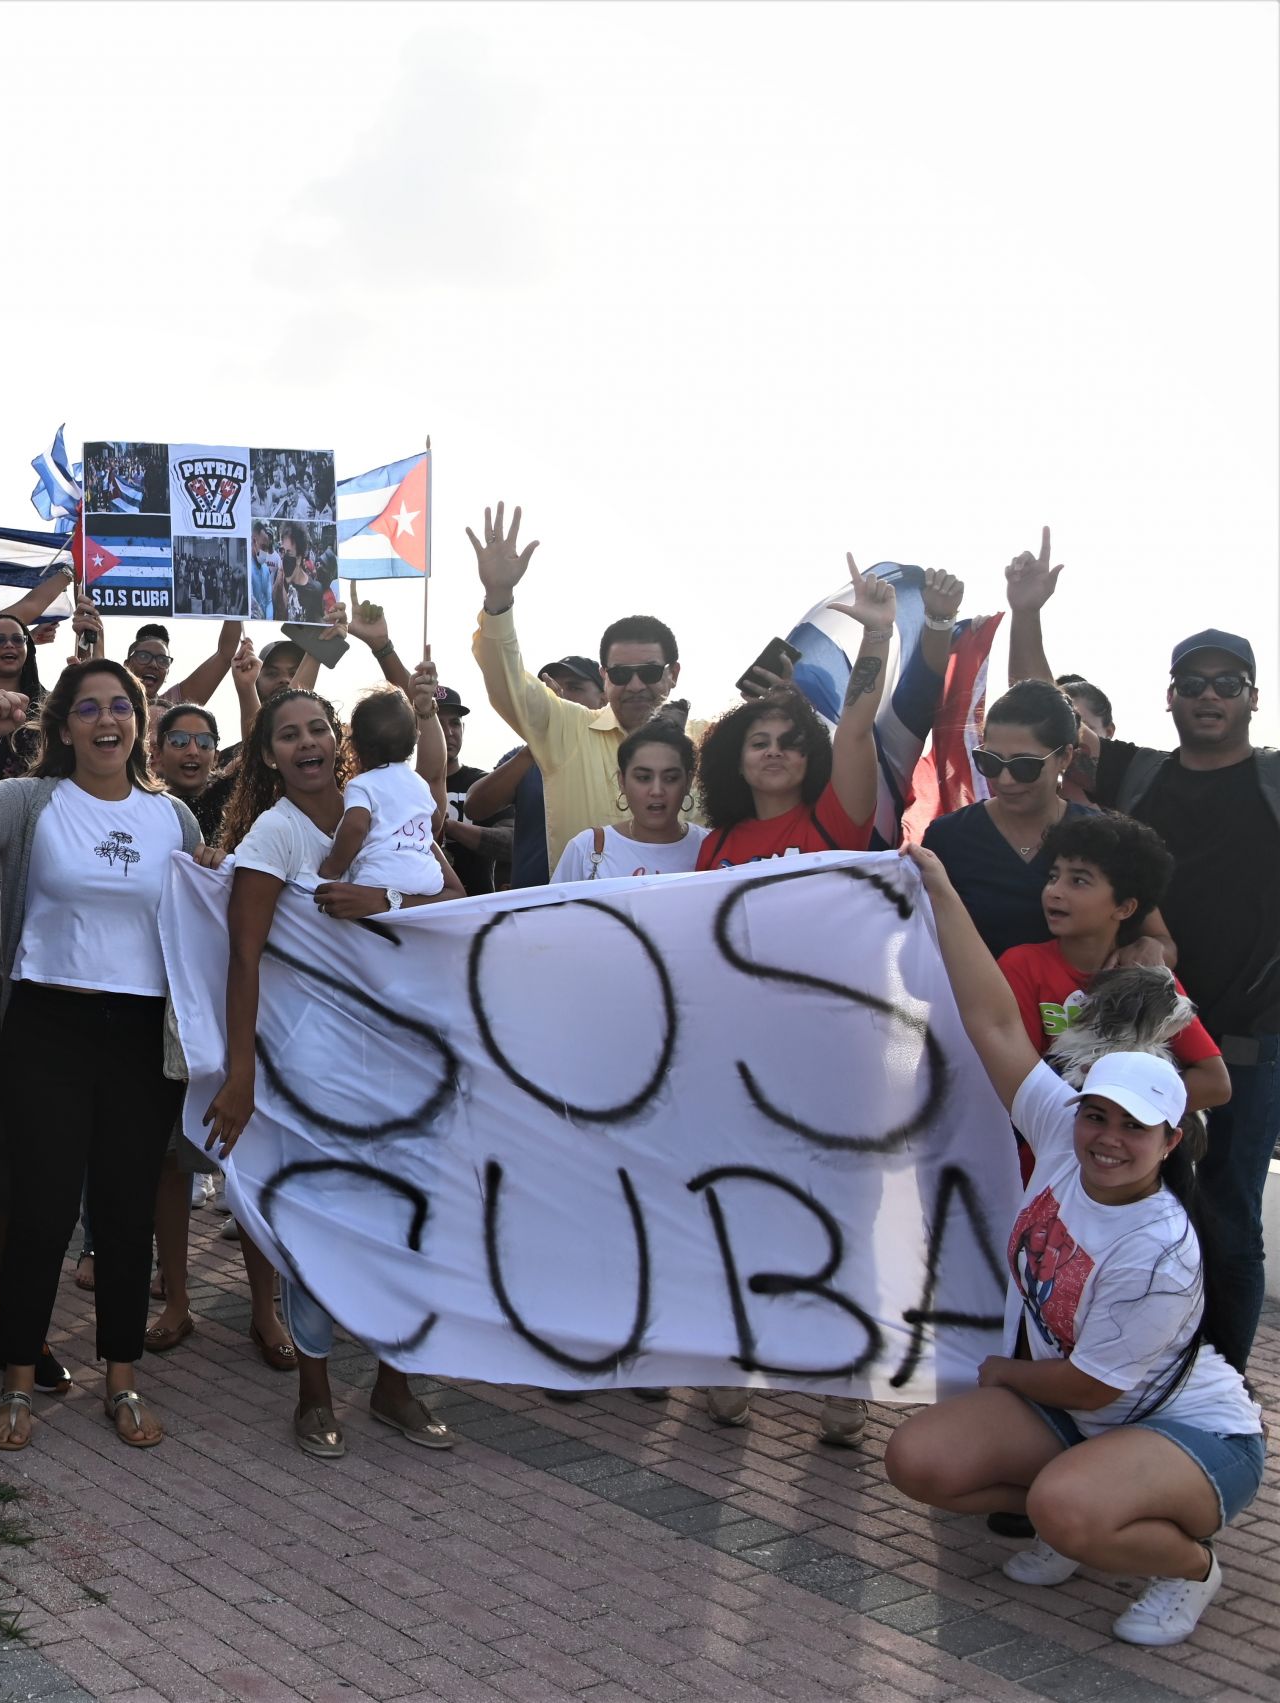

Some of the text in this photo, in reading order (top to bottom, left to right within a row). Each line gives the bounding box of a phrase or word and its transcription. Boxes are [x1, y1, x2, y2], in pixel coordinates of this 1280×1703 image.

[182, 461, 244, 480] PATRIA
[208, 478, 218, 491] Y
[195, 511, 233, 527] VIDA
[91, 588, 169, 607] S.O.S CUBA
[254, 863, 958, 1155] SOS
[258, 1157, 1010, 1390] CUBA
